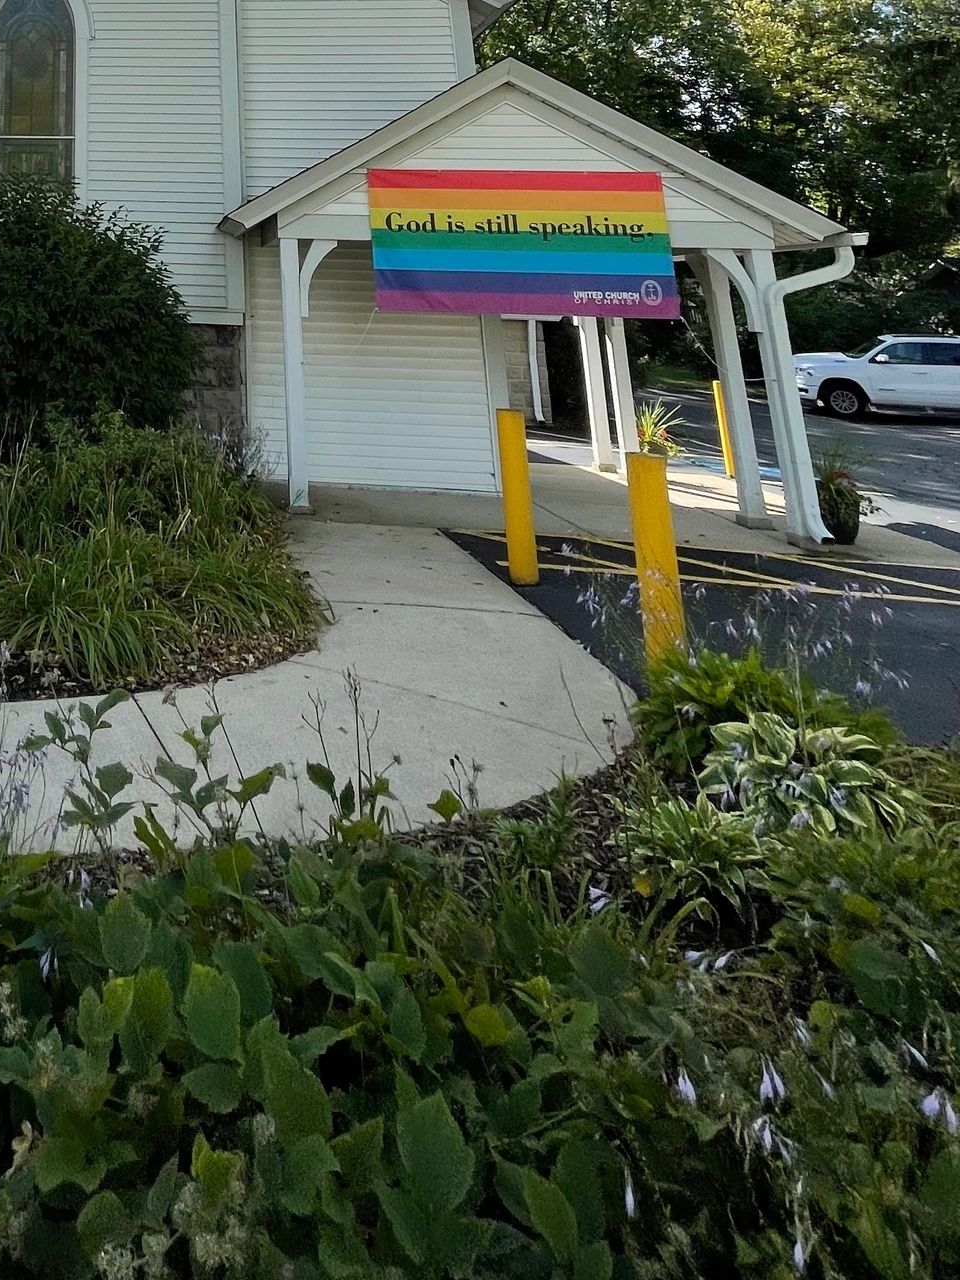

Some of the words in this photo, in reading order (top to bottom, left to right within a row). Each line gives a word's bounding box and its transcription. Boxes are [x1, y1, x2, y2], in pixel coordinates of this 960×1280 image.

[385, 211, 437, 234] God
[446, 214, 466, 234] is
[474, 213, 520, 234] still
[528, 215, 654, 244] speaking,
[573, 291, 603, 299] UNITED
[605, 291, 640, 300] CHURCH
[595, 298, 640, 306] CHRIST
